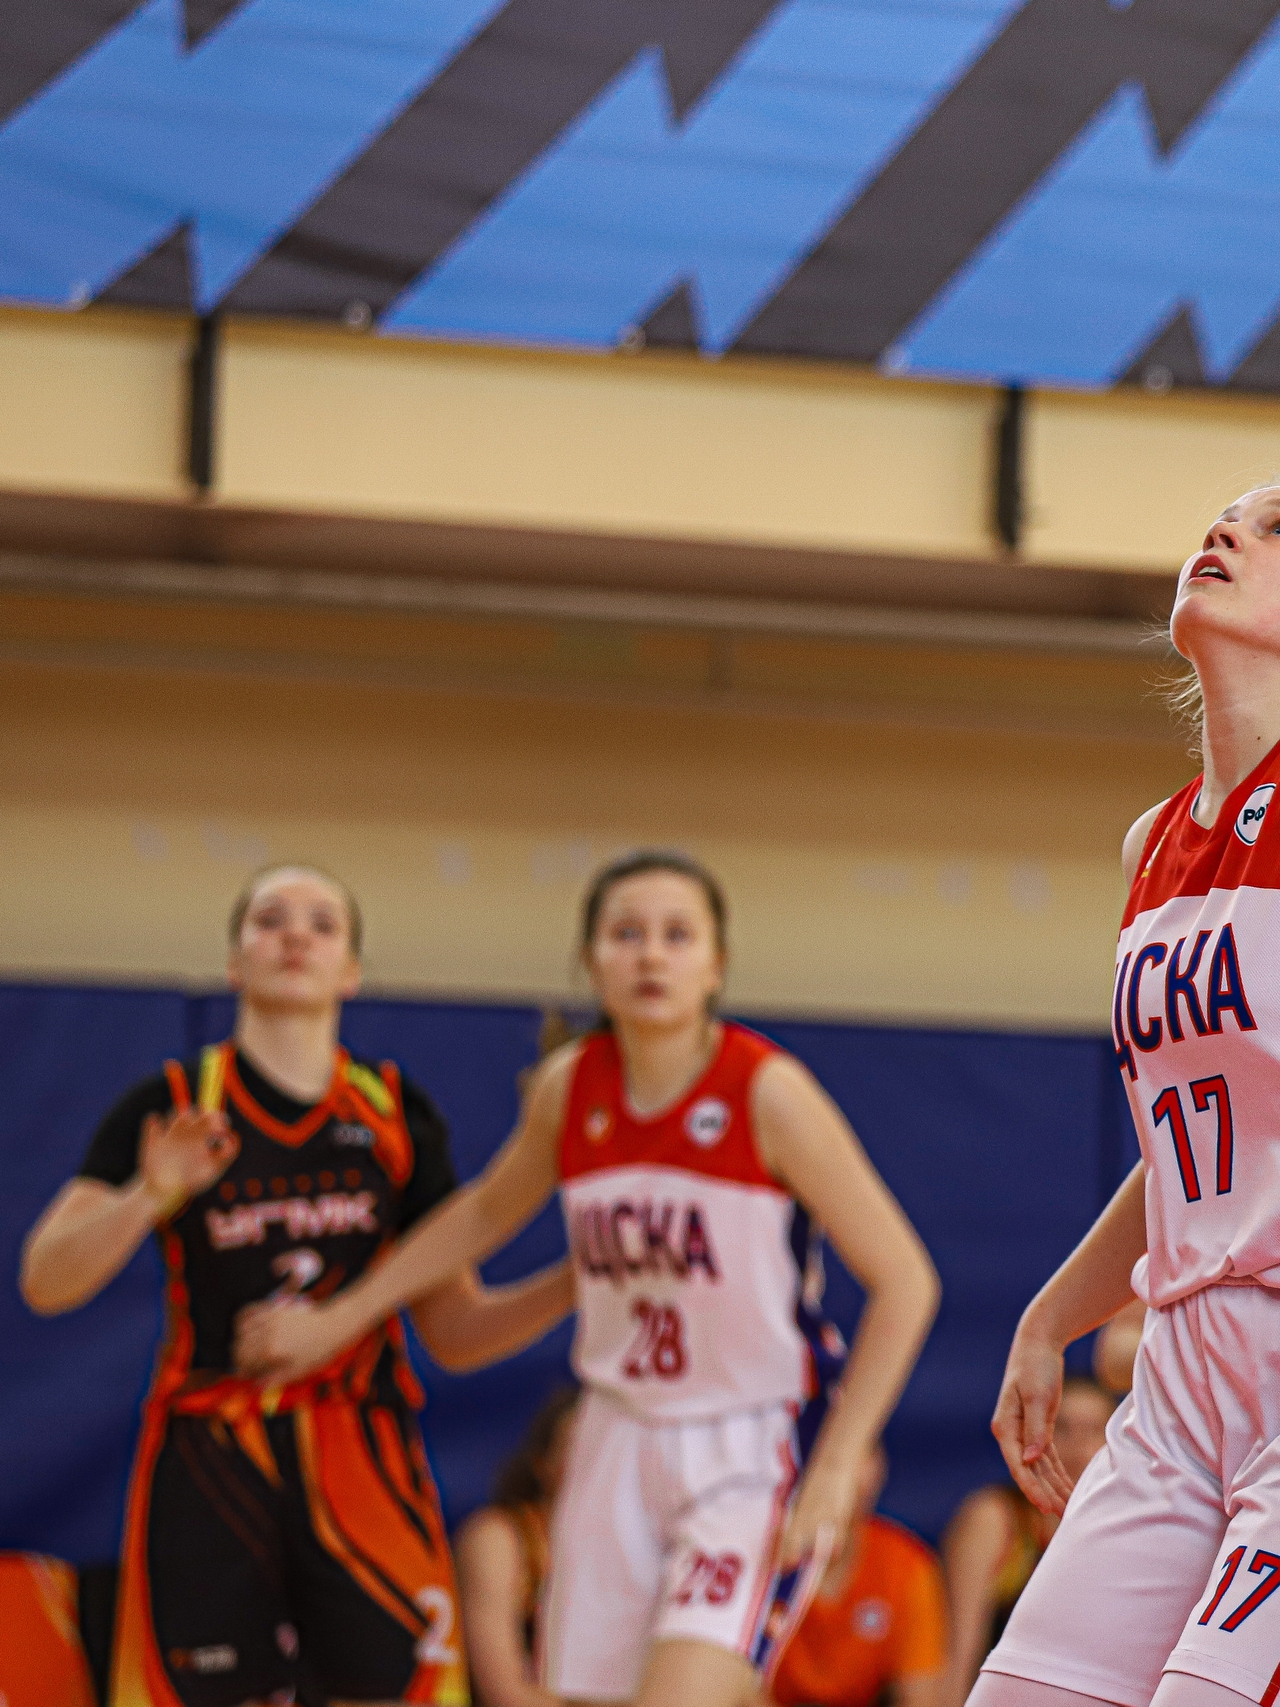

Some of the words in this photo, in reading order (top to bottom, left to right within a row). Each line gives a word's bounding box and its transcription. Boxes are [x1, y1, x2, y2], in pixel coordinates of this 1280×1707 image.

[1243, 803, 1269, 825] РФ
[1152, 1074, 1234, 1203] 17
[414, 1587, 458, 1663] 2
